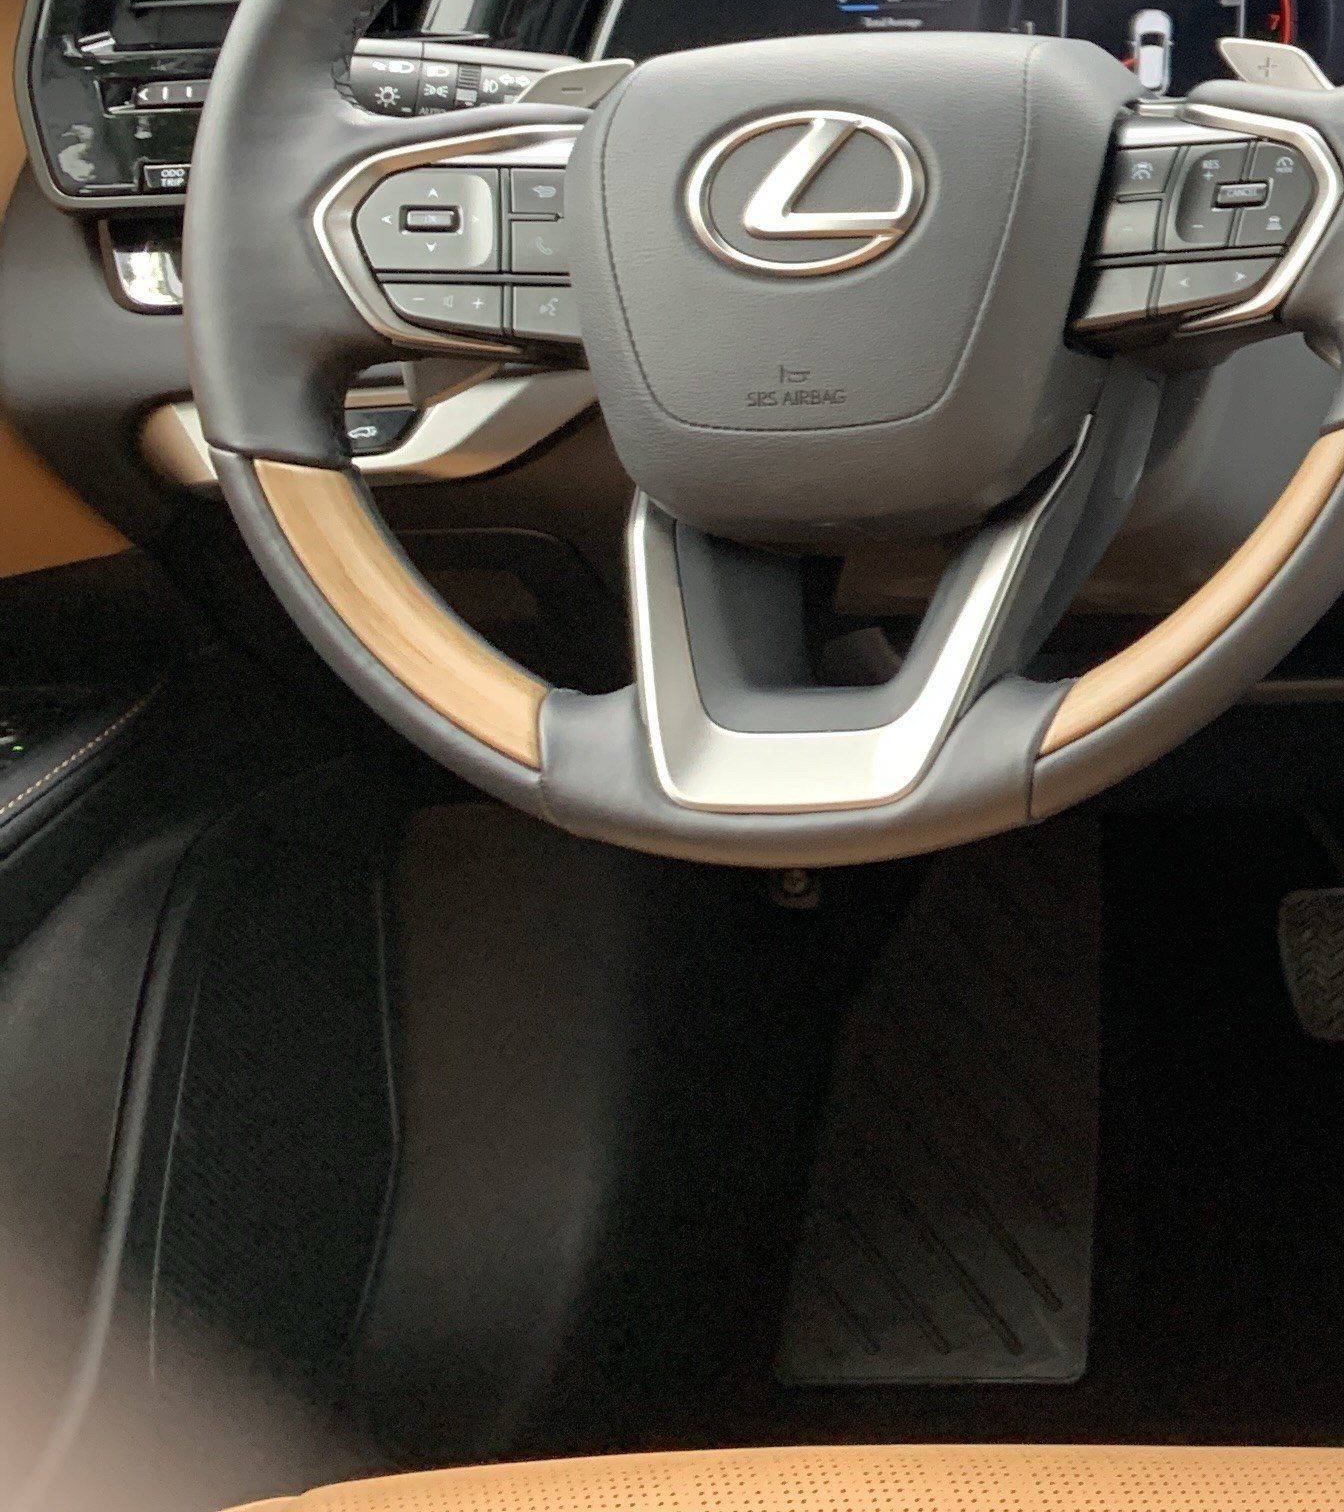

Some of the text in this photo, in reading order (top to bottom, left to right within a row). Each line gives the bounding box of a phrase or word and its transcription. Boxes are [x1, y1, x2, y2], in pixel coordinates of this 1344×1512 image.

[1268, 15, 1279, 31] 7
[161, 178, 184, 187] TRIP
[747, 390, 847, 407] SRS AIRBAG
